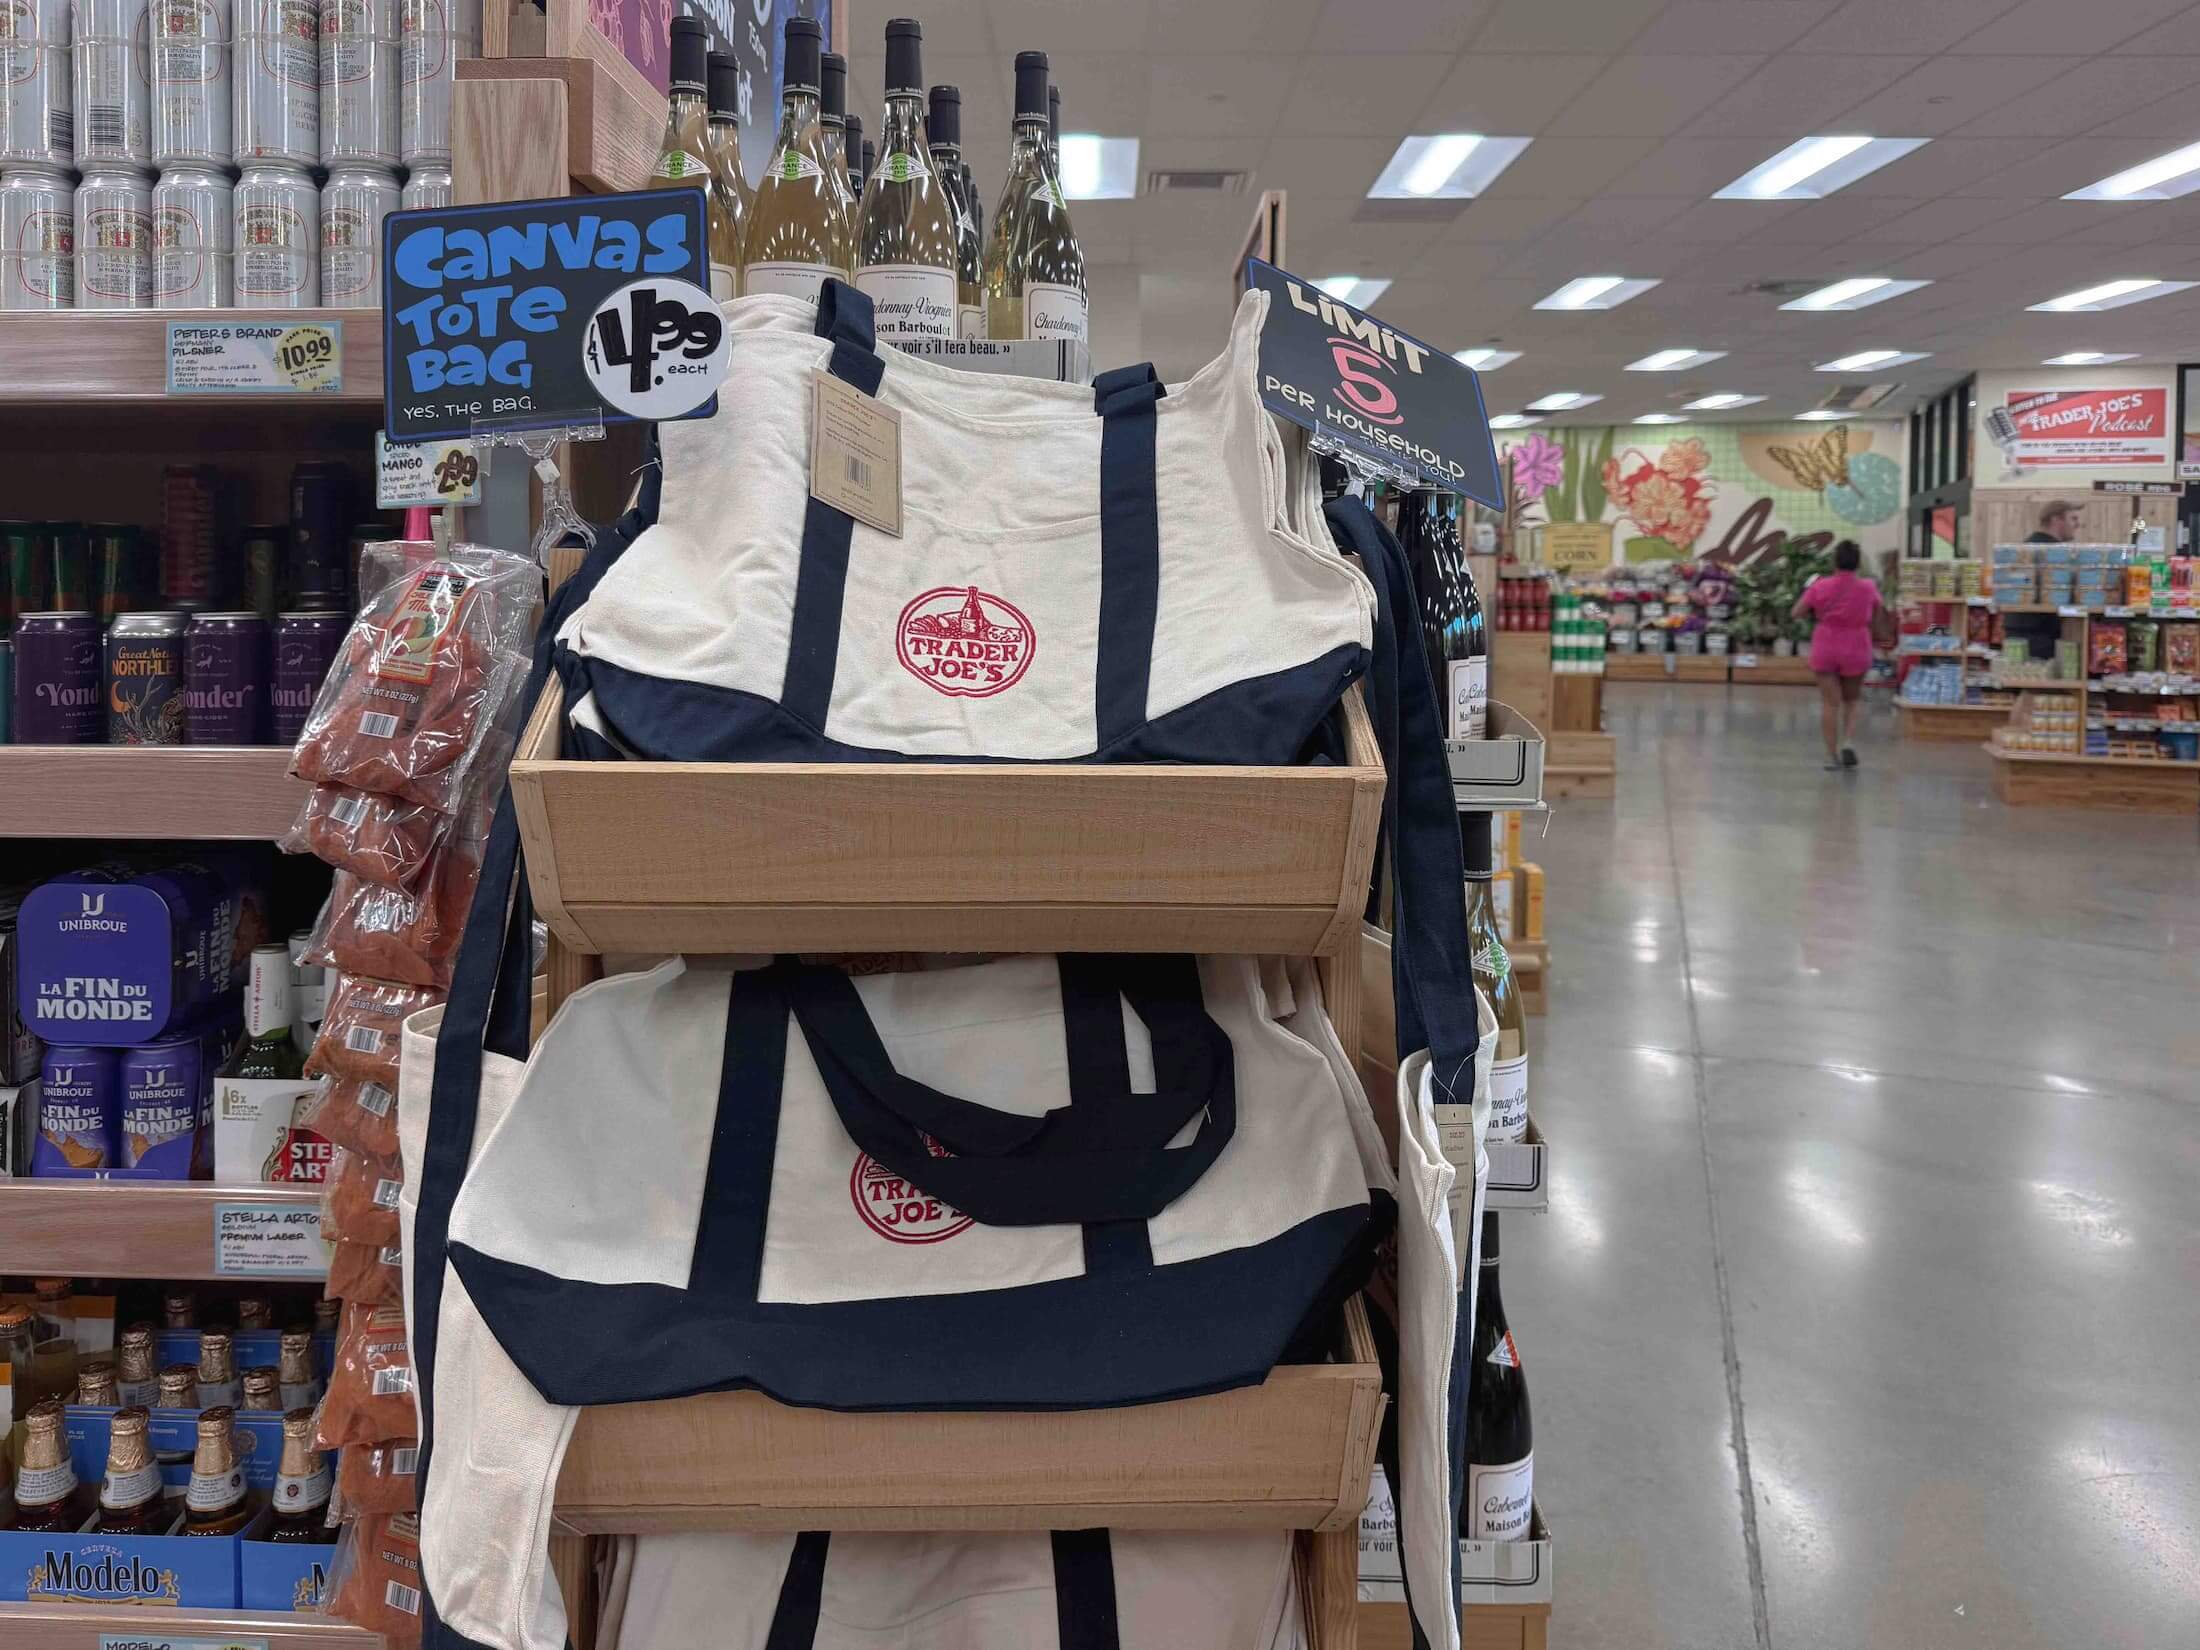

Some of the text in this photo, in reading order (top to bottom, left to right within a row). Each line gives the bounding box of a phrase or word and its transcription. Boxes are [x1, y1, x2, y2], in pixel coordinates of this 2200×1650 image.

[174, 327, 283, 340] PETERS BRAND
[172, 346, 226, 357] PILSNER
[902, 340, 923, 354] voir
[925, 340, 941, 354] s'il
[969, 340, 1000, 354] beau.
[1332, 346, 1398, 414] 5
[2031, 393, 2143, 432] TRADER JOE'S
[2088, 415, 2154, 434] Podcast
[382, 457, 423, 472] MANGO
[2183, 466, 2200, 474] SA
[907, 637, 1019, 663] TRADER
[920, 658, 1006, 682] JOE'S
[59, 919, 128, 933] UNIBROUE
[40, 977, 147, 999] LA FIN DU
[37, 998, 153, 1021] MONDE
[43, 1087, 94, 1097] UNIBROUE
[129, 1088, 185, 1100] UNIBROUE
[48, 1104, 80, 1120] FIN
[82, 1106, 100, 1116] DU
[135, 1106, 172, 1121] FIN
[175, 1107, 191, 1117] DU
[123, 1116, 194, 1134] MONDE
[222, 1212, 279, 1224] STELLA
[882, 1199, 950, 1225] JOE
[220, 1232, 307, 1242] PREMIUM LAGER
[1486, 1518, 1521, 1532] Maison
[1374, 1540, 1393, 1552] voir
[45, 1550, 161, 1595] Modelo
